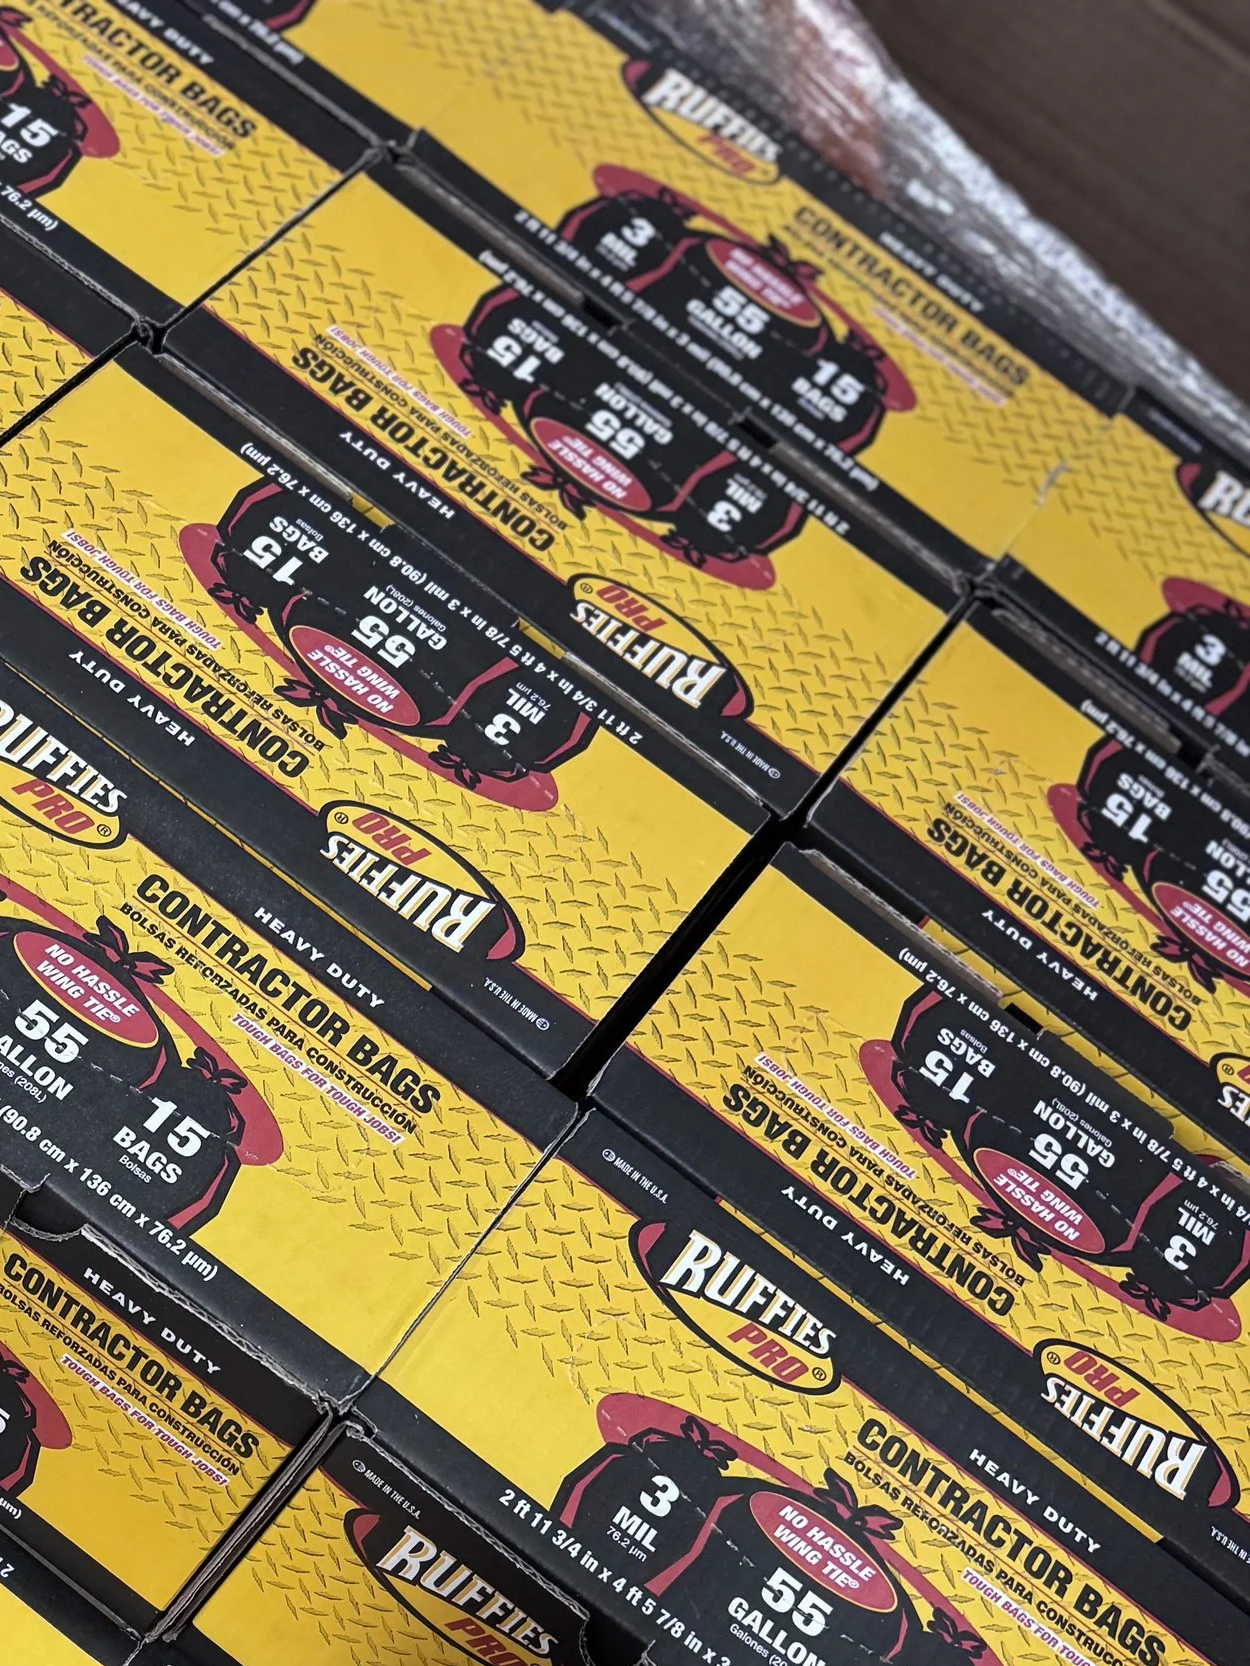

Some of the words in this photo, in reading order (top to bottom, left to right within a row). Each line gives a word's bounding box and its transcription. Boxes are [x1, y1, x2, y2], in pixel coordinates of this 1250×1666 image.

[0, 102, 60, 147] 15
[641, 71, 783, 165] RUFFIES
[483, 336, 540, 382] 15
[506, 319, 563, 363] BAGS
[19, 556, 112, 628] BAGS
[567, 599, 727, 709] RUFFIES
[99, 616, 311, 778] CONTRACTOR
[317, 831, 496, 954] RUFFIES
[927, 817, 1008, 888] BAGS
[253, 908, 325, 963] HEAVY
[326, 964, 385, 1010] DUTY
[981, 909, 1033, 951] DUTY
[1002, 876, 1192, 1032] CONTRACTOR
[136, 872, 356, 1049] CONTRACTOR
[345, 1035, 441, 1116] BAGS
[1035, 951, 1098, 1001] HEAVY
[14, 998, 89, 1063] 55
[112, 1125, 183, 1183] BAGS
[143, 1095, 214, 1156] 15
[721, 1084, 812, 1161] BAGS
[613, 1158, 634, 1176] MADE
[630, 1171, 641, 1183] IN
[638, 1176, 653, 1191] THE
[649, 1185, 668, 1205] U.S.A.
[805, 1147, 1016, 1317] CONTRACTOR
[660, 1228, 838, 1358] RUFFIES
[4, 1252, 184, 1403] CONTRACTOR
[181, 1388, 260, 1459] BAGS
[1038, 1373, 1206, 1501] RUFFIES
[856, 1417, 1079, 1601] CONTRACTOR
[377, 1525, 560, 1655] RUFFIES
[730, 1623, 770, 1659] Galones
